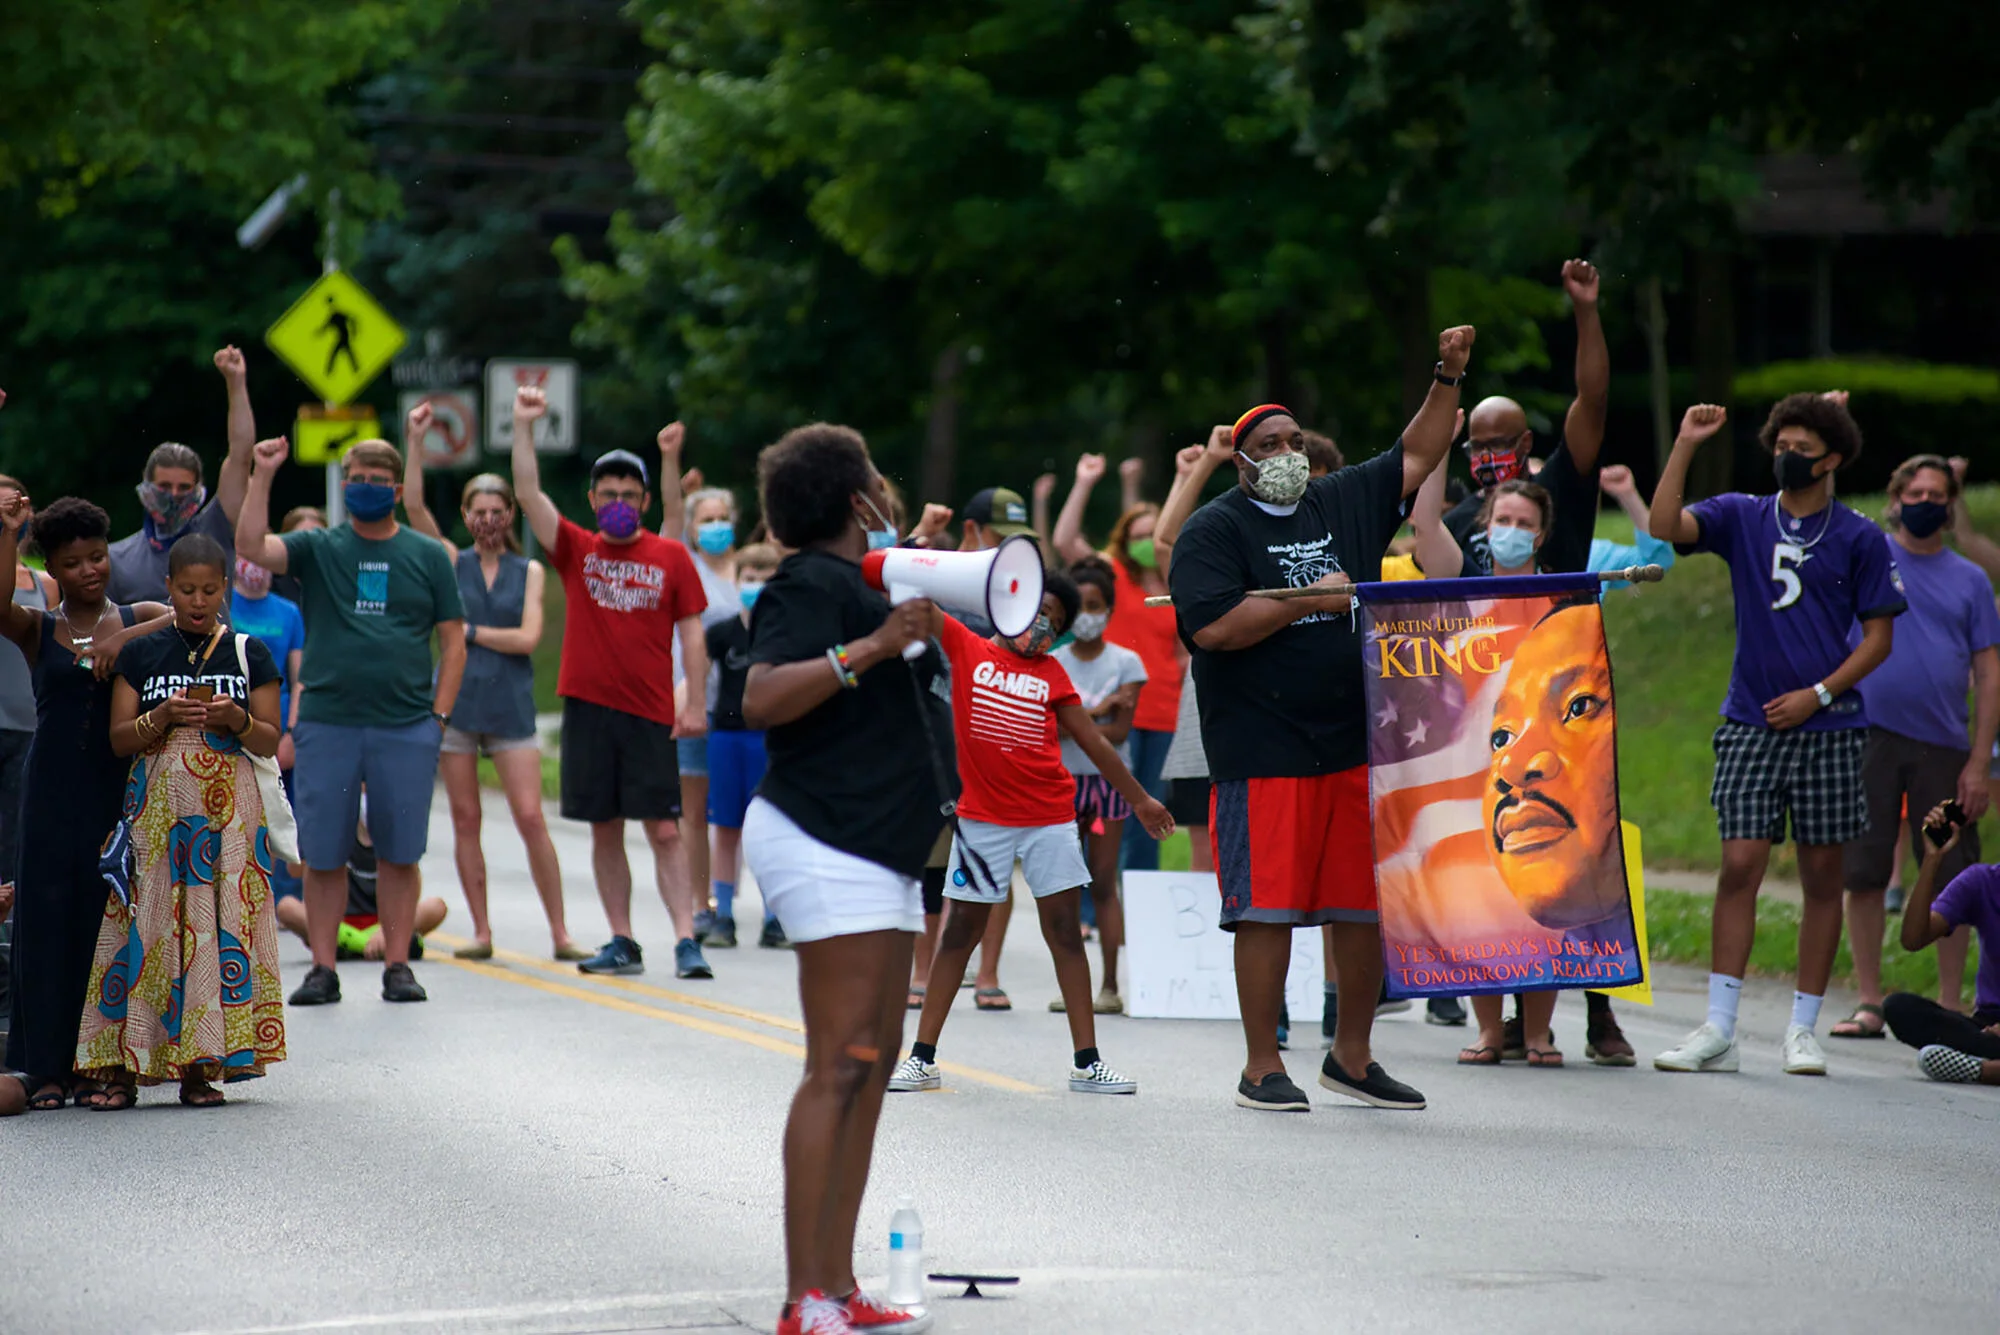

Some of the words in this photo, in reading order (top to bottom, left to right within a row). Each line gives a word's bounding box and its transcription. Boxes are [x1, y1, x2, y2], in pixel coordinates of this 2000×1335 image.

[583, 552, 665, 588] TEMPLE
[1771, 543, 1802, 610] 5
[1374, 620, 1432, 634] MARTIN
[1437, 616, 1495, 632] LUTHER
[1376, 633, 1502, 678] KING
[1476, 640, 1490, 653] JR
[972, 660, 1050, 703] GAMER
[1395, 936, 1539, 963] YESTERDAY'S
[1546, 938, 1624, 957] DREAM
[1398, 958, 1544, 986] TOMORROW'S
[1551, 957, 1628, 978] REALITY
